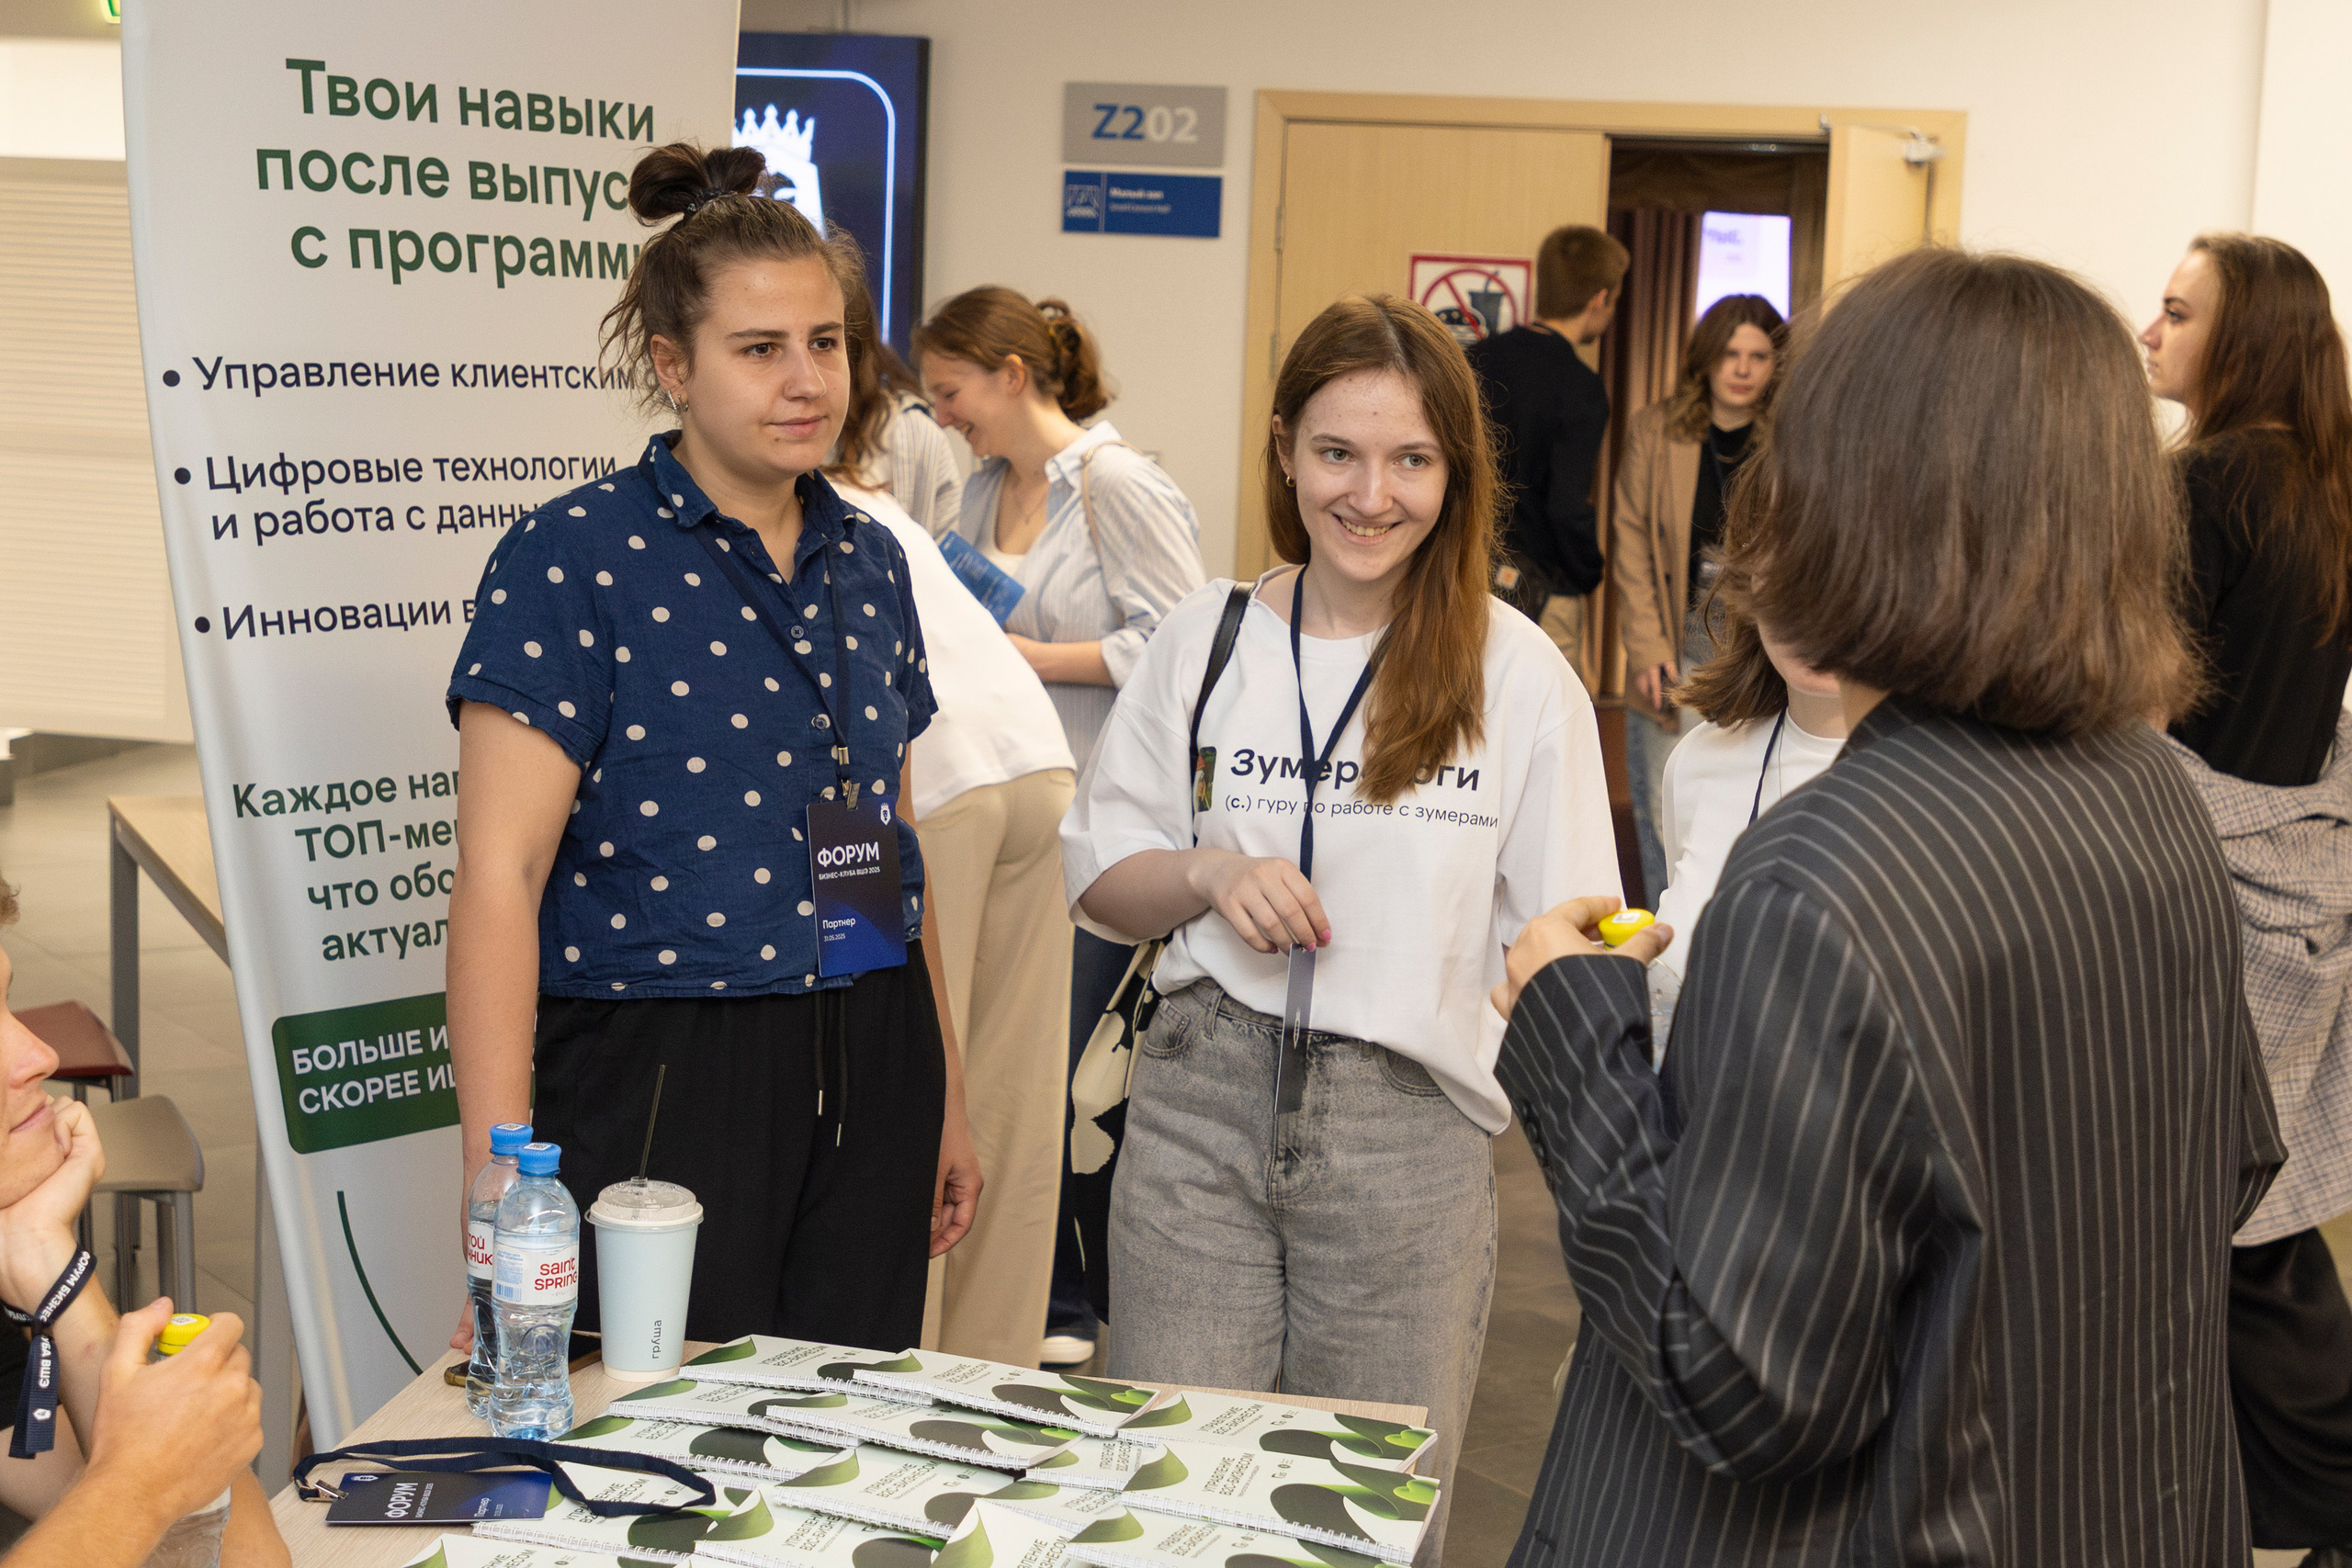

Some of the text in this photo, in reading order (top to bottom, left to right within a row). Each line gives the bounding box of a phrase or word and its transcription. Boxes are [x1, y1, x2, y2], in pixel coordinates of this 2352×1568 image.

[286, 57, 655, 143] Твои навыки
[1091, 103, 1198, 142] Z202
[256, 148, 629, 221] после выпус
[290, 224, 328, 269] с
[192, 355, 441, 398] Управление
[450, 363, 636, 389] клиентским
[206, 453, 616, 496] Цифровые технологии
[211, 511, 239, 540] и
[254, 497, 395, 546] работа
[405, 504, 426, 531] с
[223, 598, 452, 640] Инновации
[1229, 748, 1481, 792] Зумероги
[232, 776, 398, 818] Каждое
[1257, 797, 1297, 815] гуру
[1330, 798, 1394, 818] работе
[1398, 804, 1410, 817] с
[1415, 806, 1499, 829] зумерами
[296, 818, 458, 862] ТОП-ме
[817, 841, 880, 867] ФОРУМ
[307, 861, 456, 911] что обо
[819, 869, 856, 880] БИЗНЕС-КЛУБА
[322, 918, 449, 961] актуал
[822, 918, 855, 931] Партнер
[292, 1024, 450, 1075] БОЛЬШЕ И
[299, 1069, 422, 1114] СКОРЕЕ
[40, 1250, 91, 1324] ФОРУМ БИЗНЕС
[651, 1319, 662, 1359] груша
[39, 1336, 52, 1388] УБА ВШЭ
[1202, 1457, 1235, 1493] УПРАВЛЕНИЕ
[384, 1482, 419, 1518] ФОРУМ
[781, 1512, 823, 1547] УПРАВЛЕНИ
[798, 1515, 842, 1551] B2C-БИЗНЕ
